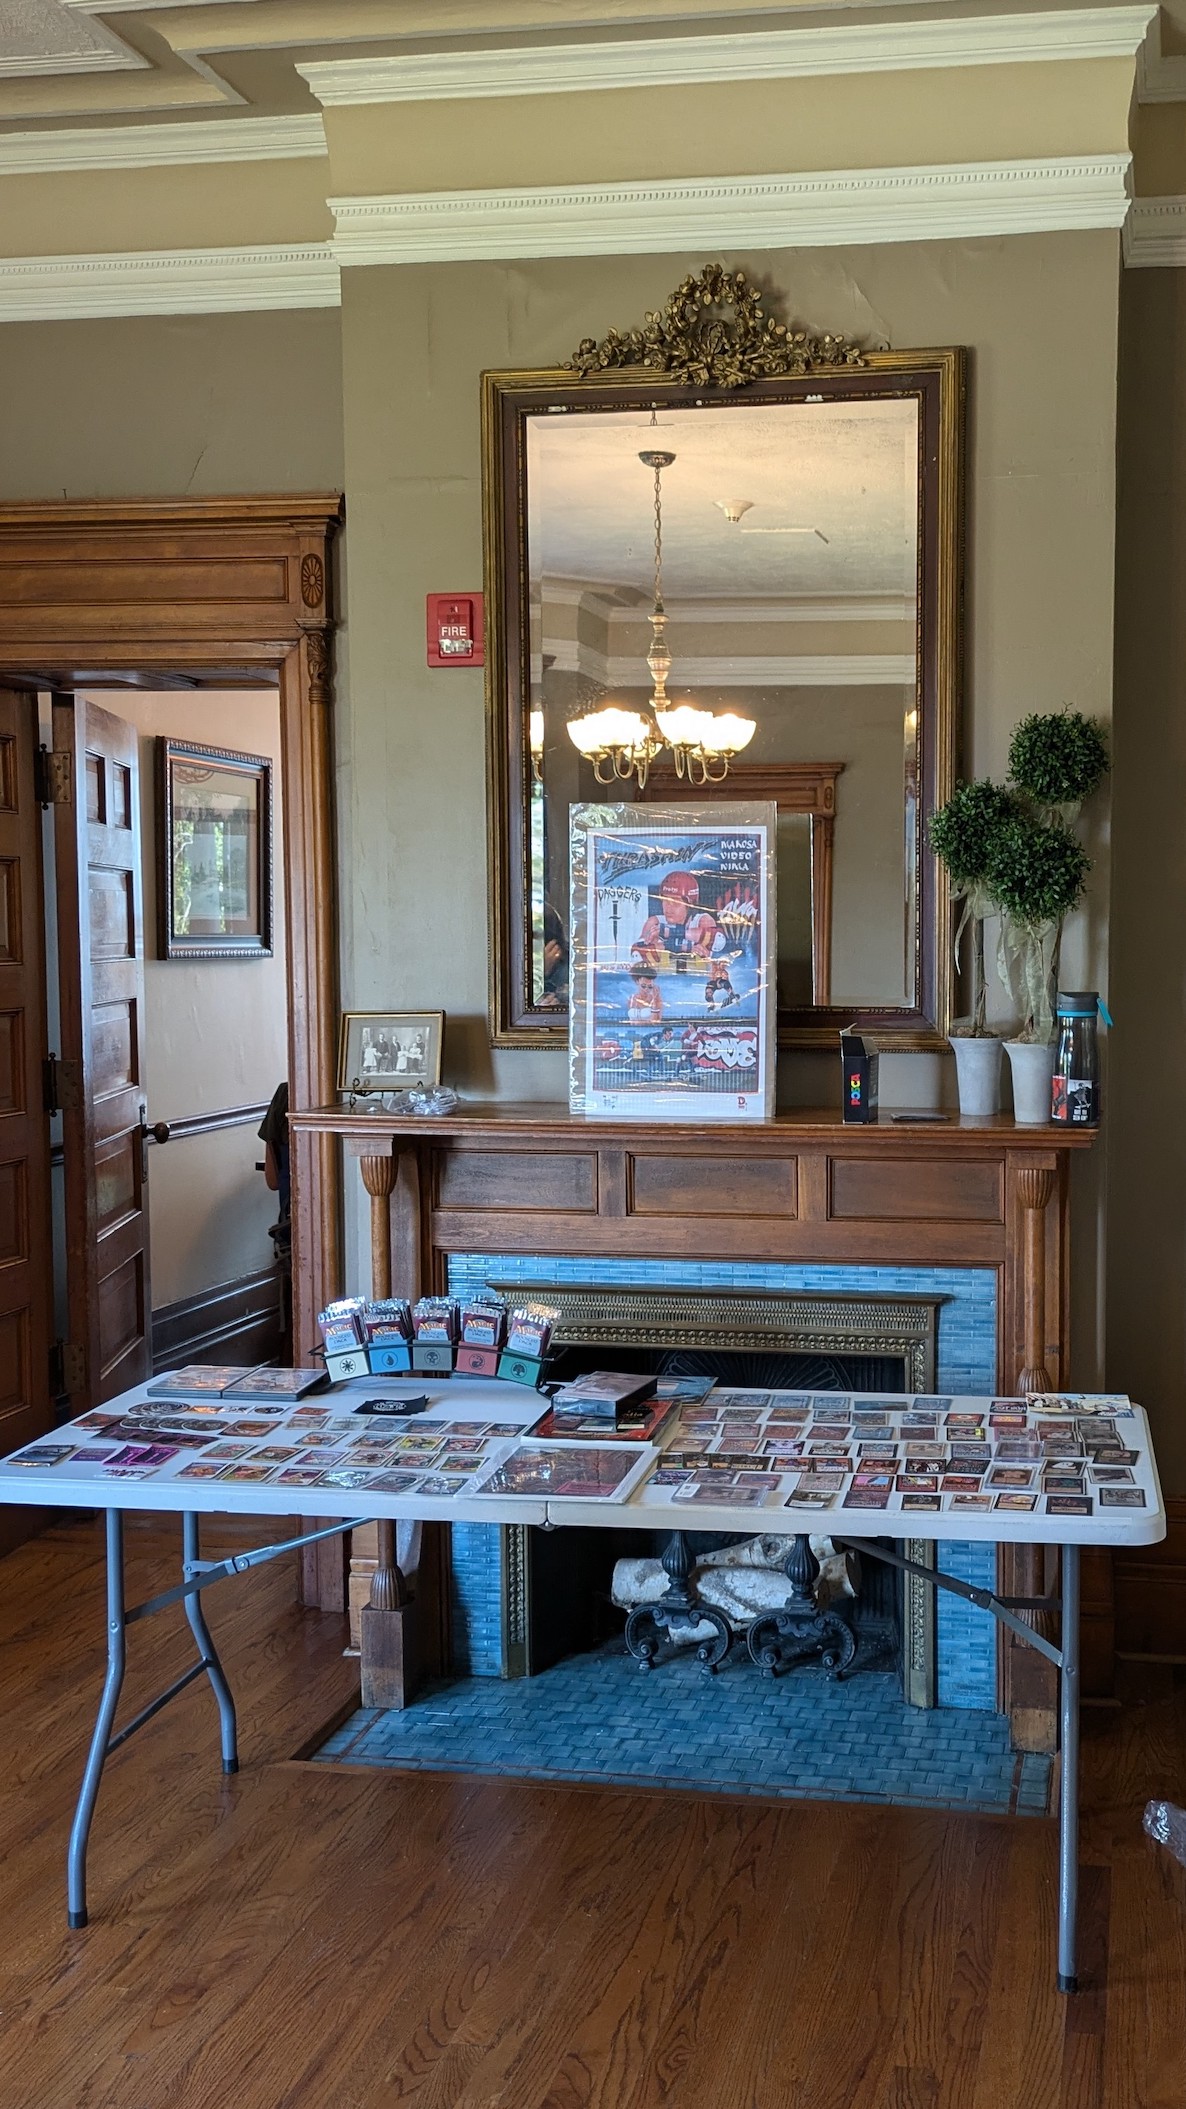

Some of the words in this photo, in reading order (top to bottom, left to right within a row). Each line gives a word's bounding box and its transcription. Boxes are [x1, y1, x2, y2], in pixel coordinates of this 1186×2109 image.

[441, 626, 467, 637] FIRE
[719, 851, 752, 860] VIDEO
[597, 885, 642, 904] DAGGERS
[850, 1073, 861, 1106] POSCA
